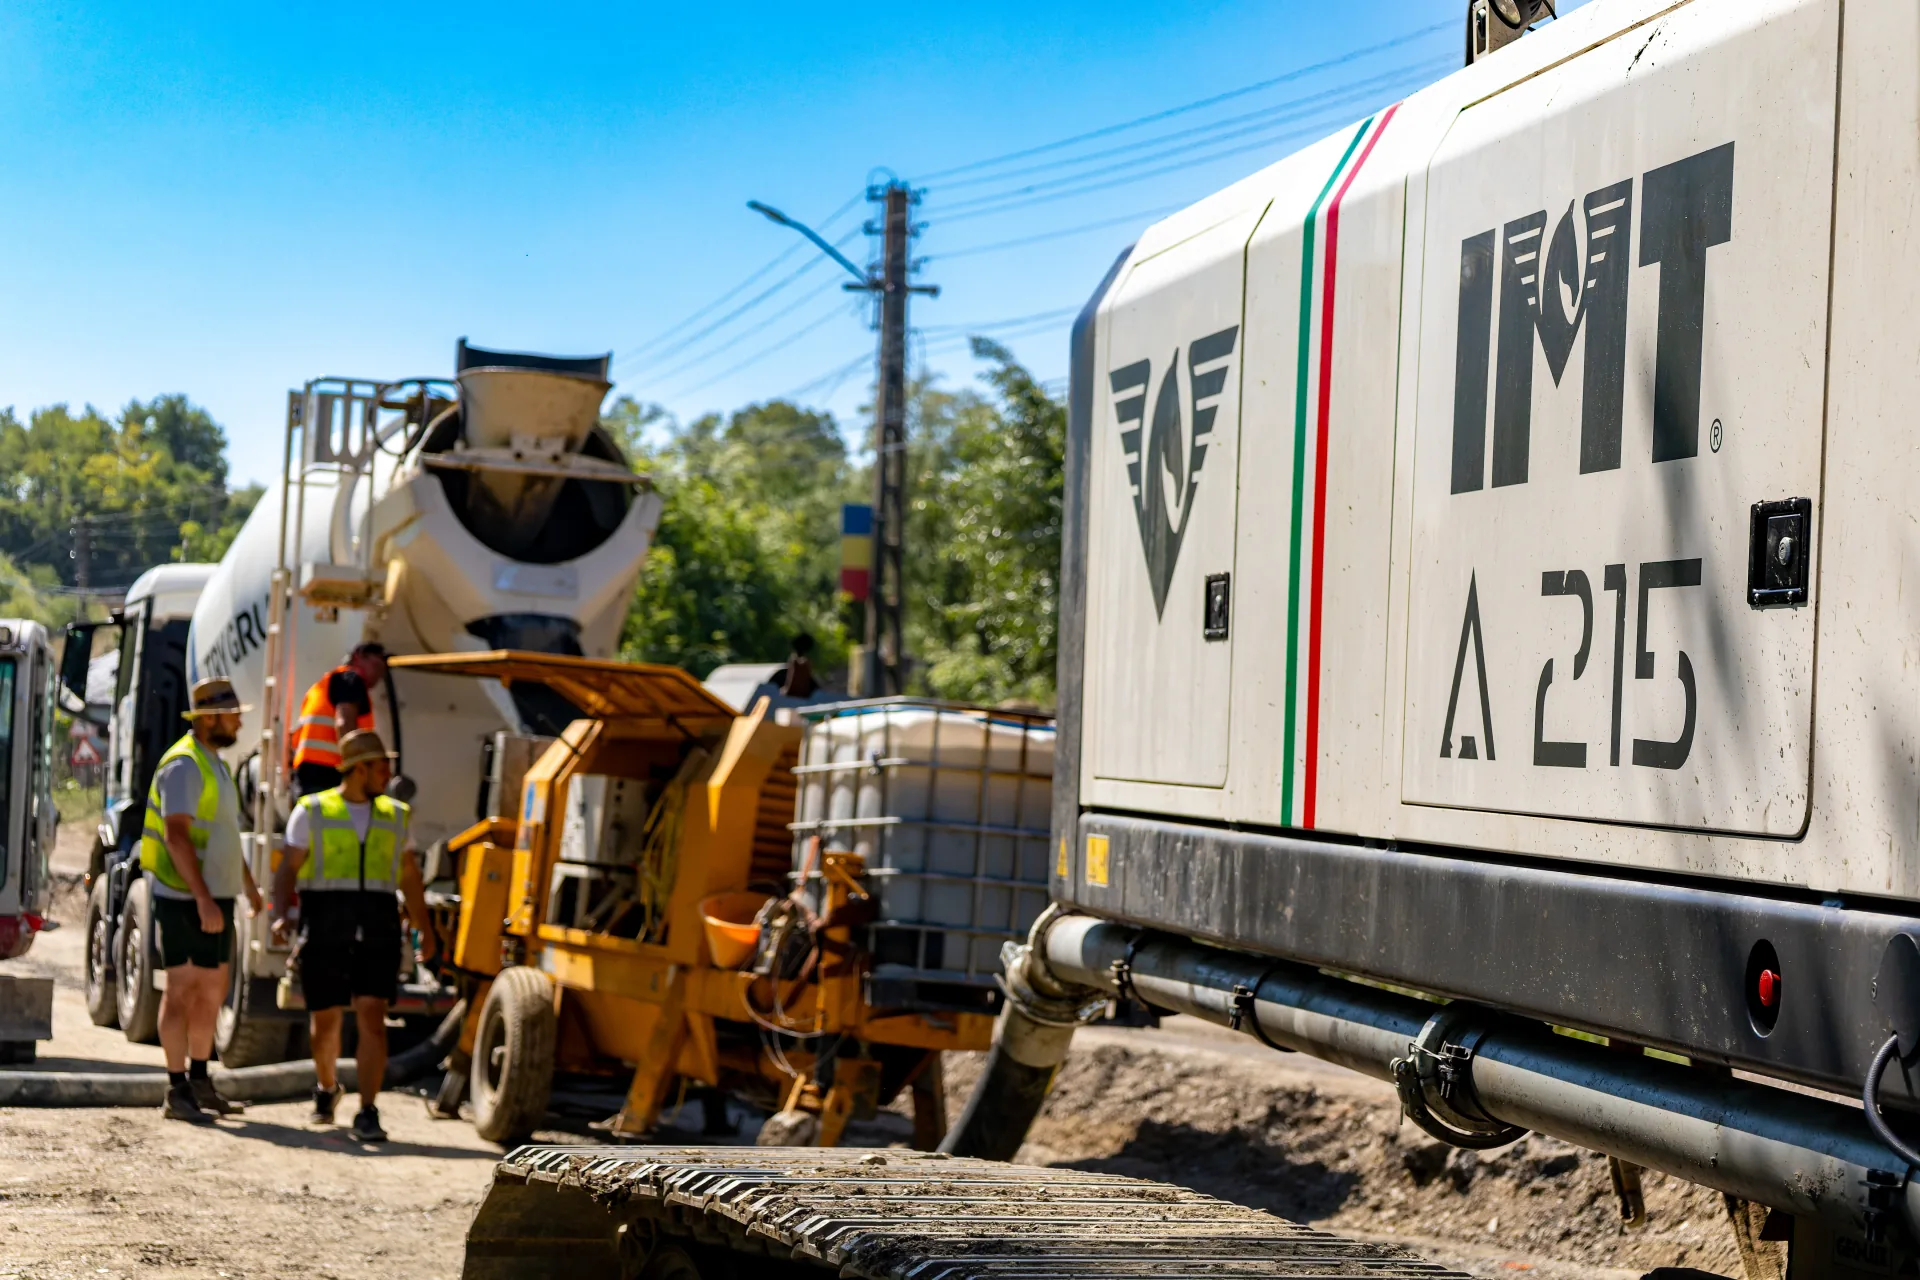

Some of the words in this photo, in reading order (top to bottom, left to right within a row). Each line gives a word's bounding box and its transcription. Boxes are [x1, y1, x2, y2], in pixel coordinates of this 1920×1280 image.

[1450, 141, 1735, 495] IMT
[1439, 566, 1496, 761] A
[1533, 557, 1702, 770] 215
